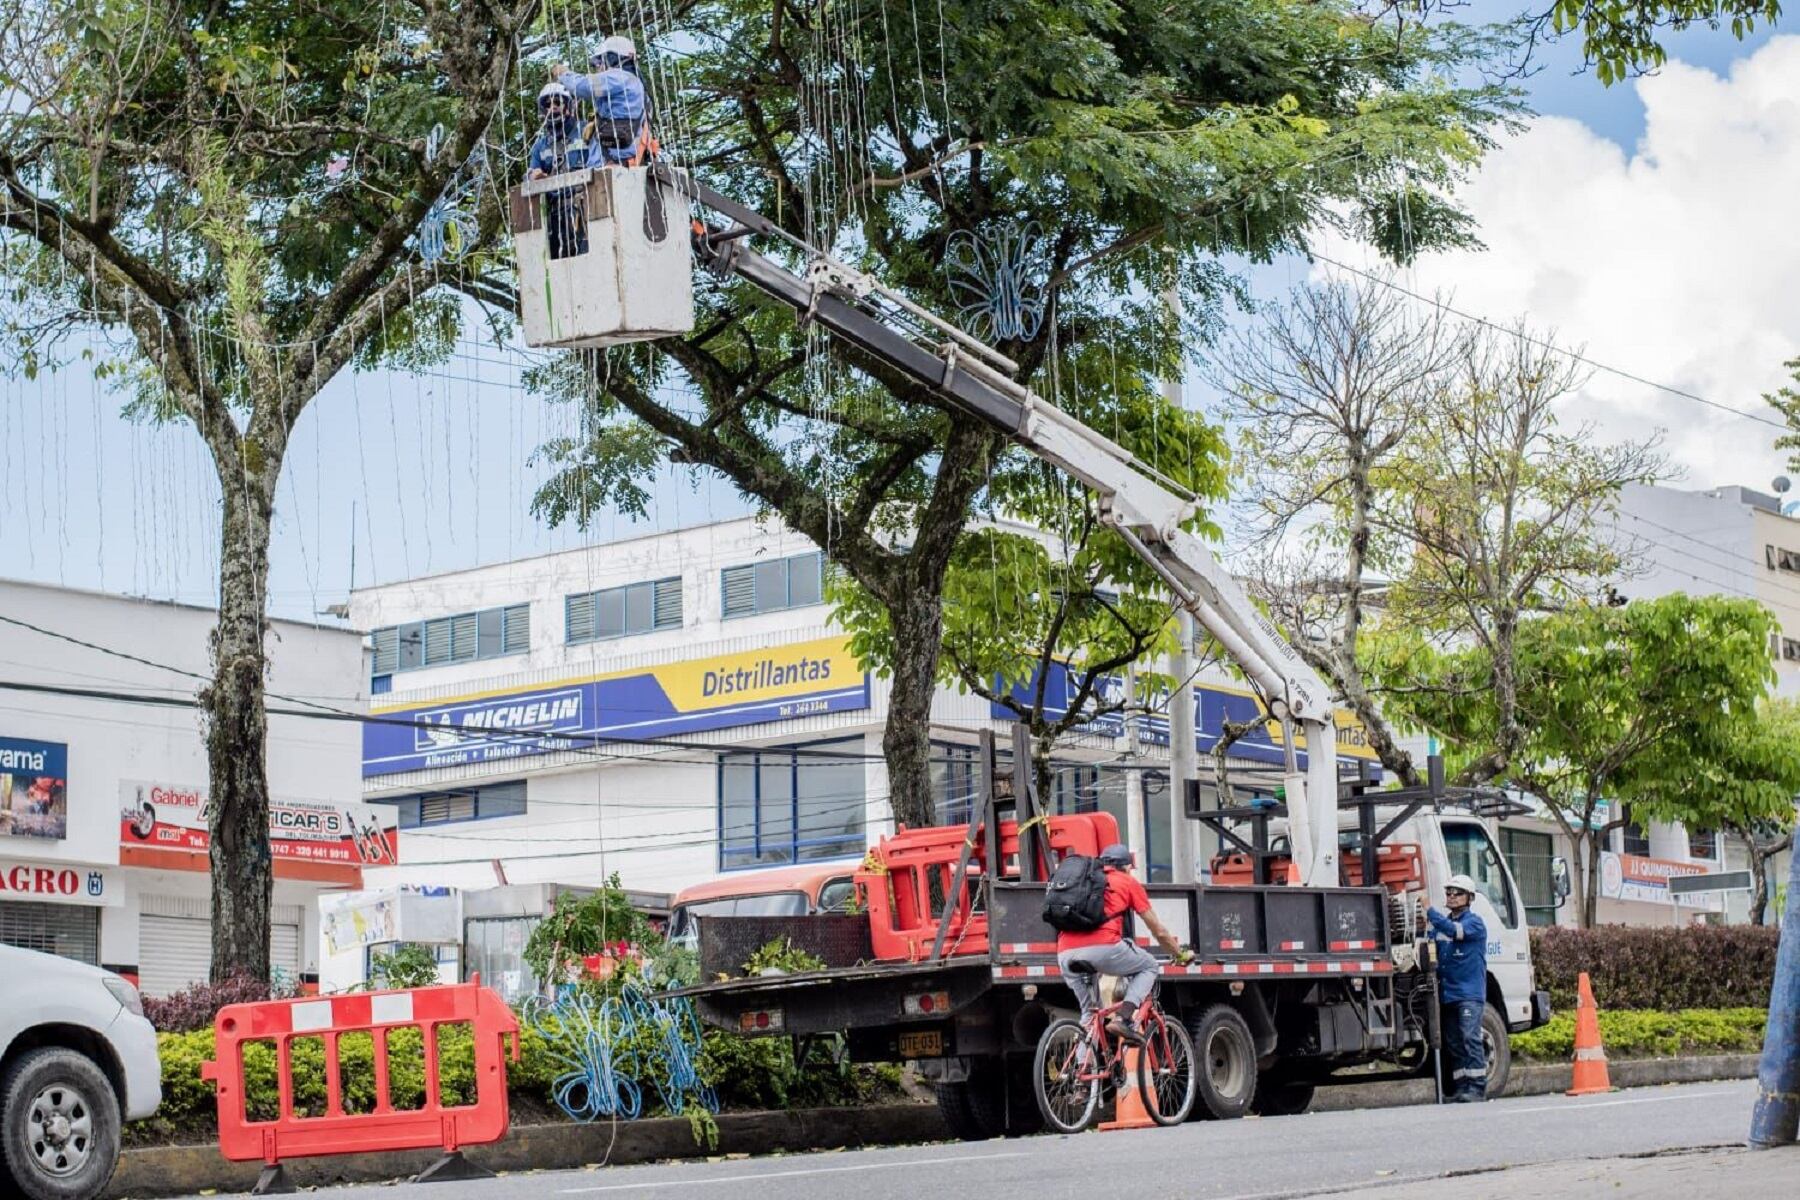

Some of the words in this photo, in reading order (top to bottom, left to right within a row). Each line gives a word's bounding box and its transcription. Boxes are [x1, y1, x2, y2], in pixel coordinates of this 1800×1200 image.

[703, 656, 831, 697] Distrillantas
[463, 697, 579, 728] MICHELIN
[151, 787, 199, 806] Gabriel
